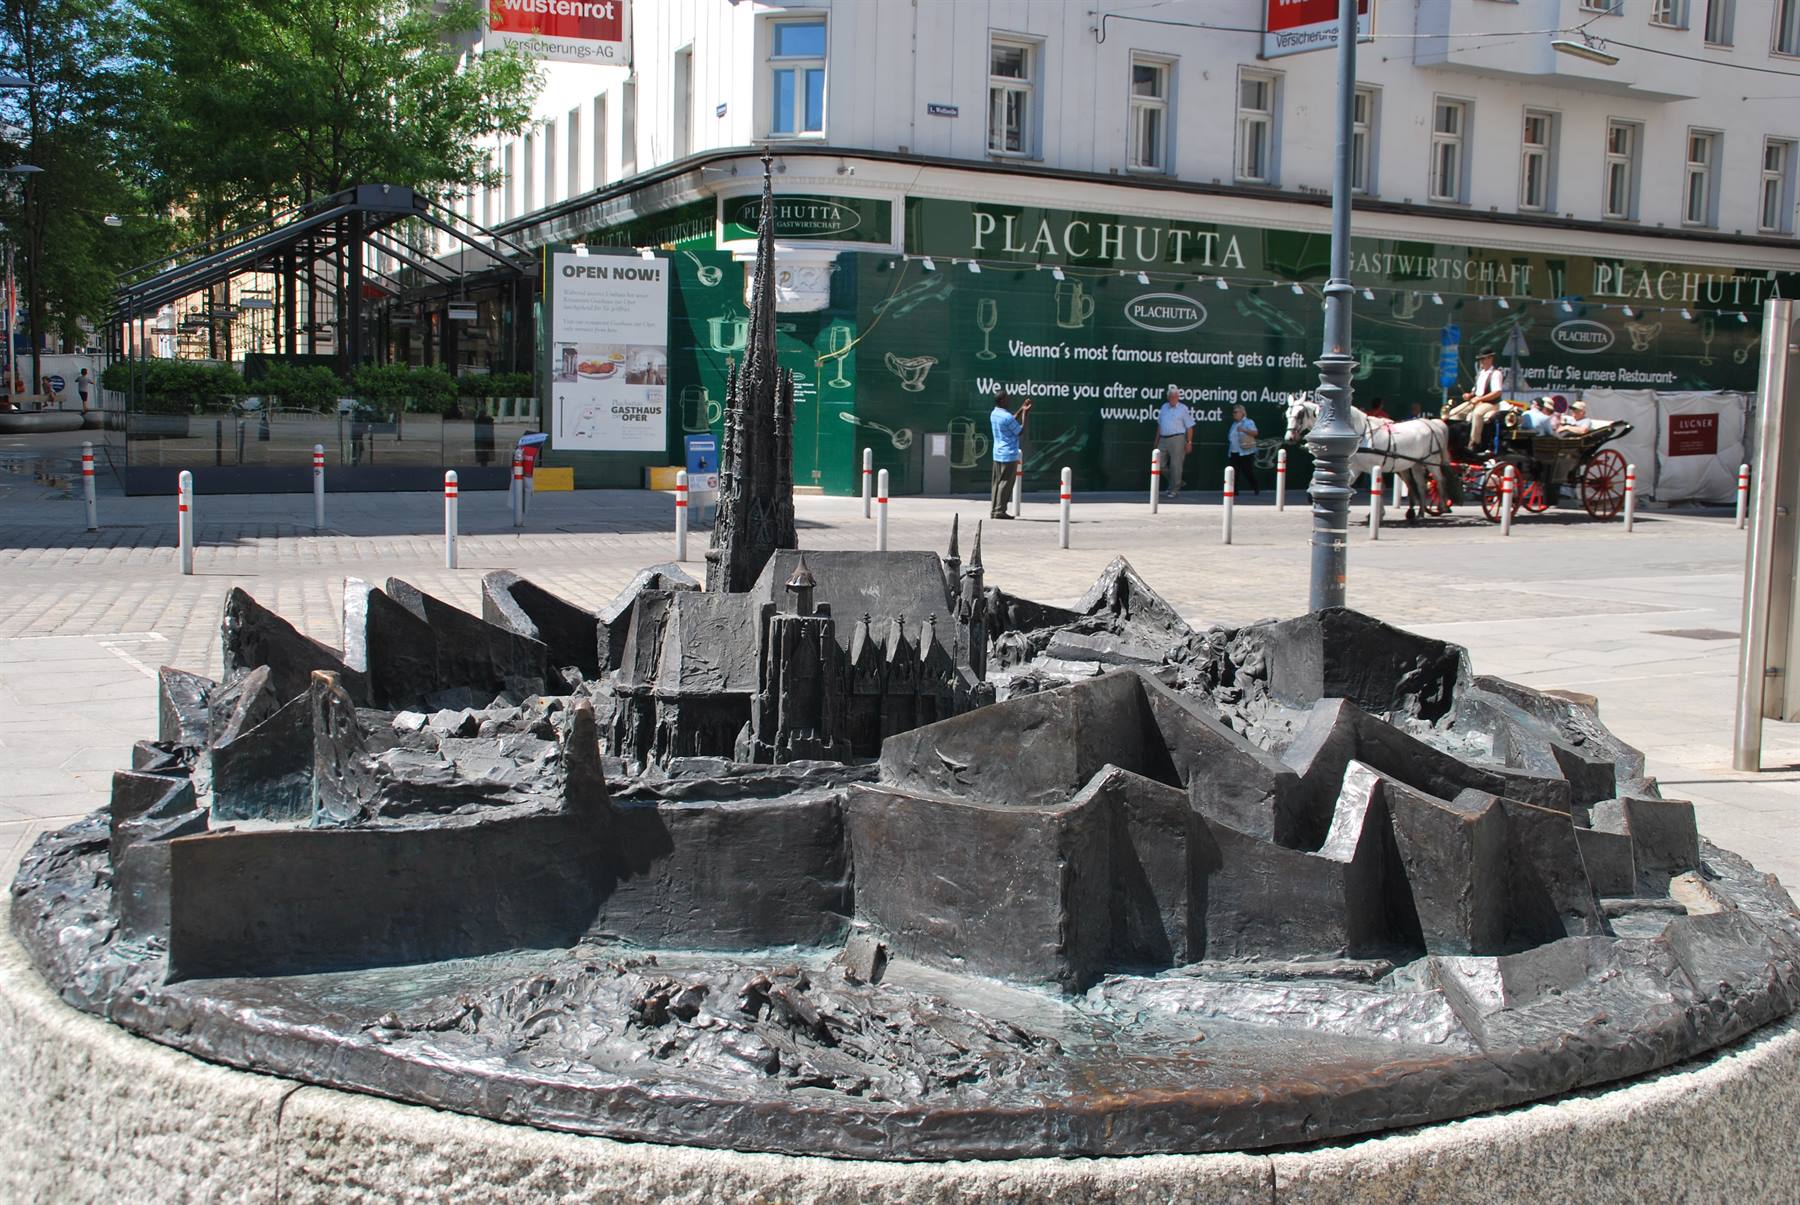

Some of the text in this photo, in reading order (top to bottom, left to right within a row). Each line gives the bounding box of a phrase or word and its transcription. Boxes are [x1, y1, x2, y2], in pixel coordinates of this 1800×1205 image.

[1276, 22, 1360, 47] Versicherung
[503, 37, 614, 58] Versicherungs-AG
[744, 205, 841, 220] PLHUTTA
[776, 221, 841, 229] GASTWIRTSCHAFT
[971, 211, 1246, 270] PLACHUTTA
[562, 265, 660, 282] OPEN NOW!
[1594, 264, 1781, 306] PLACHUTTA
[1134, 305, 1198, 320] PLACHUTTA
[1558, 330, 1608, 344] PLACHUTTA
[1074, 345, 1108, 360] most
[1112, 344, 1162, 362] famous
[1166, 349, 1234, 365] restaurant
[1237, 351, 1263, 368] gets
[1266, 355, 1275, 367] a
[1278, 352, 1307, 368] refit.
[1548, 365, 1563, 379] für
[1566, 365, 1581, 380] Sie
[1583, 368, 1616, 381] unsere
[1618, 368, 1677, 384] Restaurant-
[976, 378, 1001, 394] We
[1006, 379, 1069, 396] welcome
[1073, 384, 1099, 400] you
[1103, 382, 1138, 398] after
[1141, 387, 1165, 399] our
[1241, 390, 1257, 401] on
[611, 406, 662, 415] GASTHAUS
[621, 413, 647, 422] OPER
[1100, 404, 1223, 423] www.plata.at
[1680, 419, 1713, 429] LUGNER
